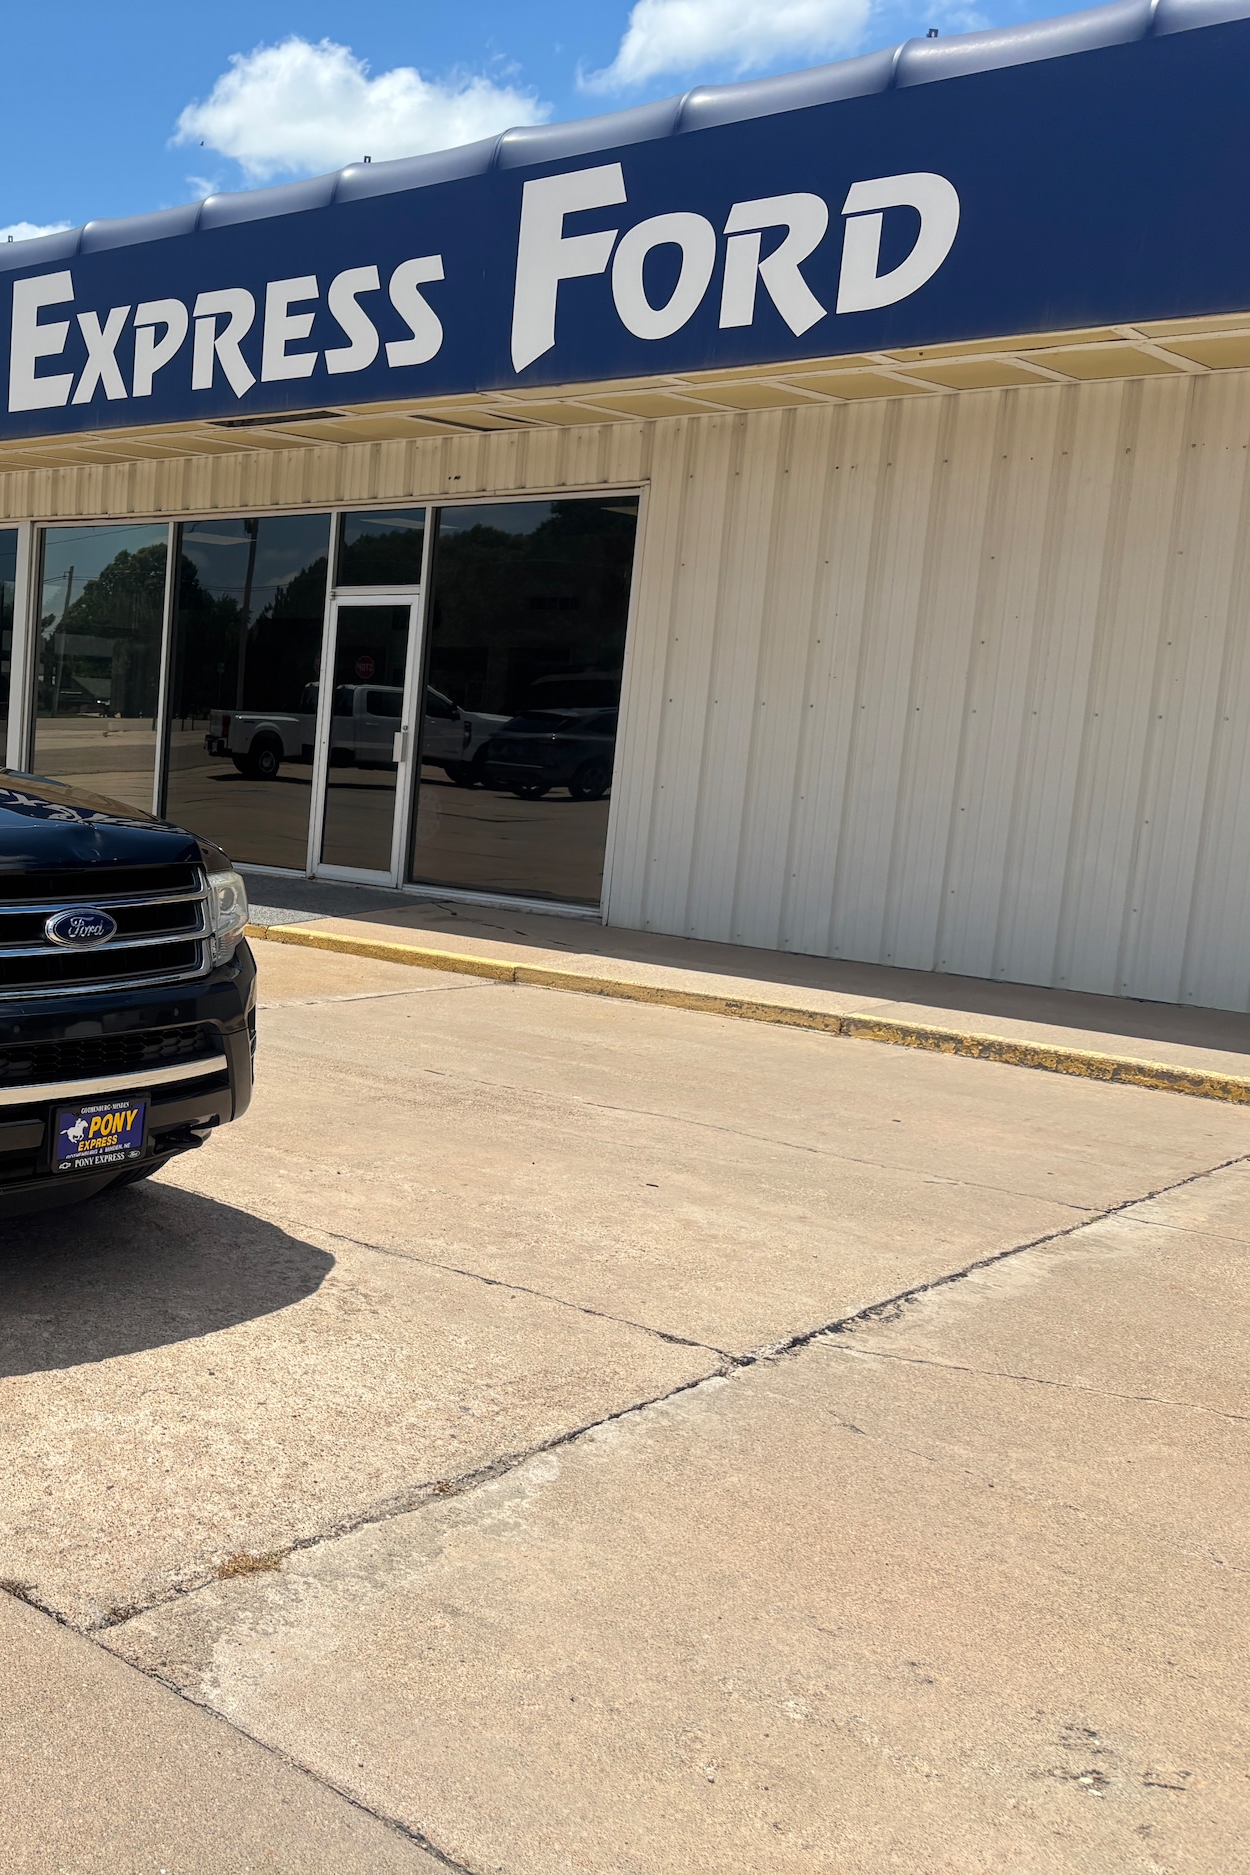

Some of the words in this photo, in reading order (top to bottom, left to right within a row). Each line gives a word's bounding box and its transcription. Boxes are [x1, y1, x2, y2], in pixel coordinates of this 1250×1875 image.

[9, 255, 445, 413] EXPRESS
[511, 162, 960, 373] FORD
[68, 916, 104, 938] Ford
[88, 1109, 138, 1138] PONY
[78, 1135, 117, 1151] EXPRESS
[75, 1157, 94, 1167] PONY
[95, 1152, 124, 1164] EXPRESS
